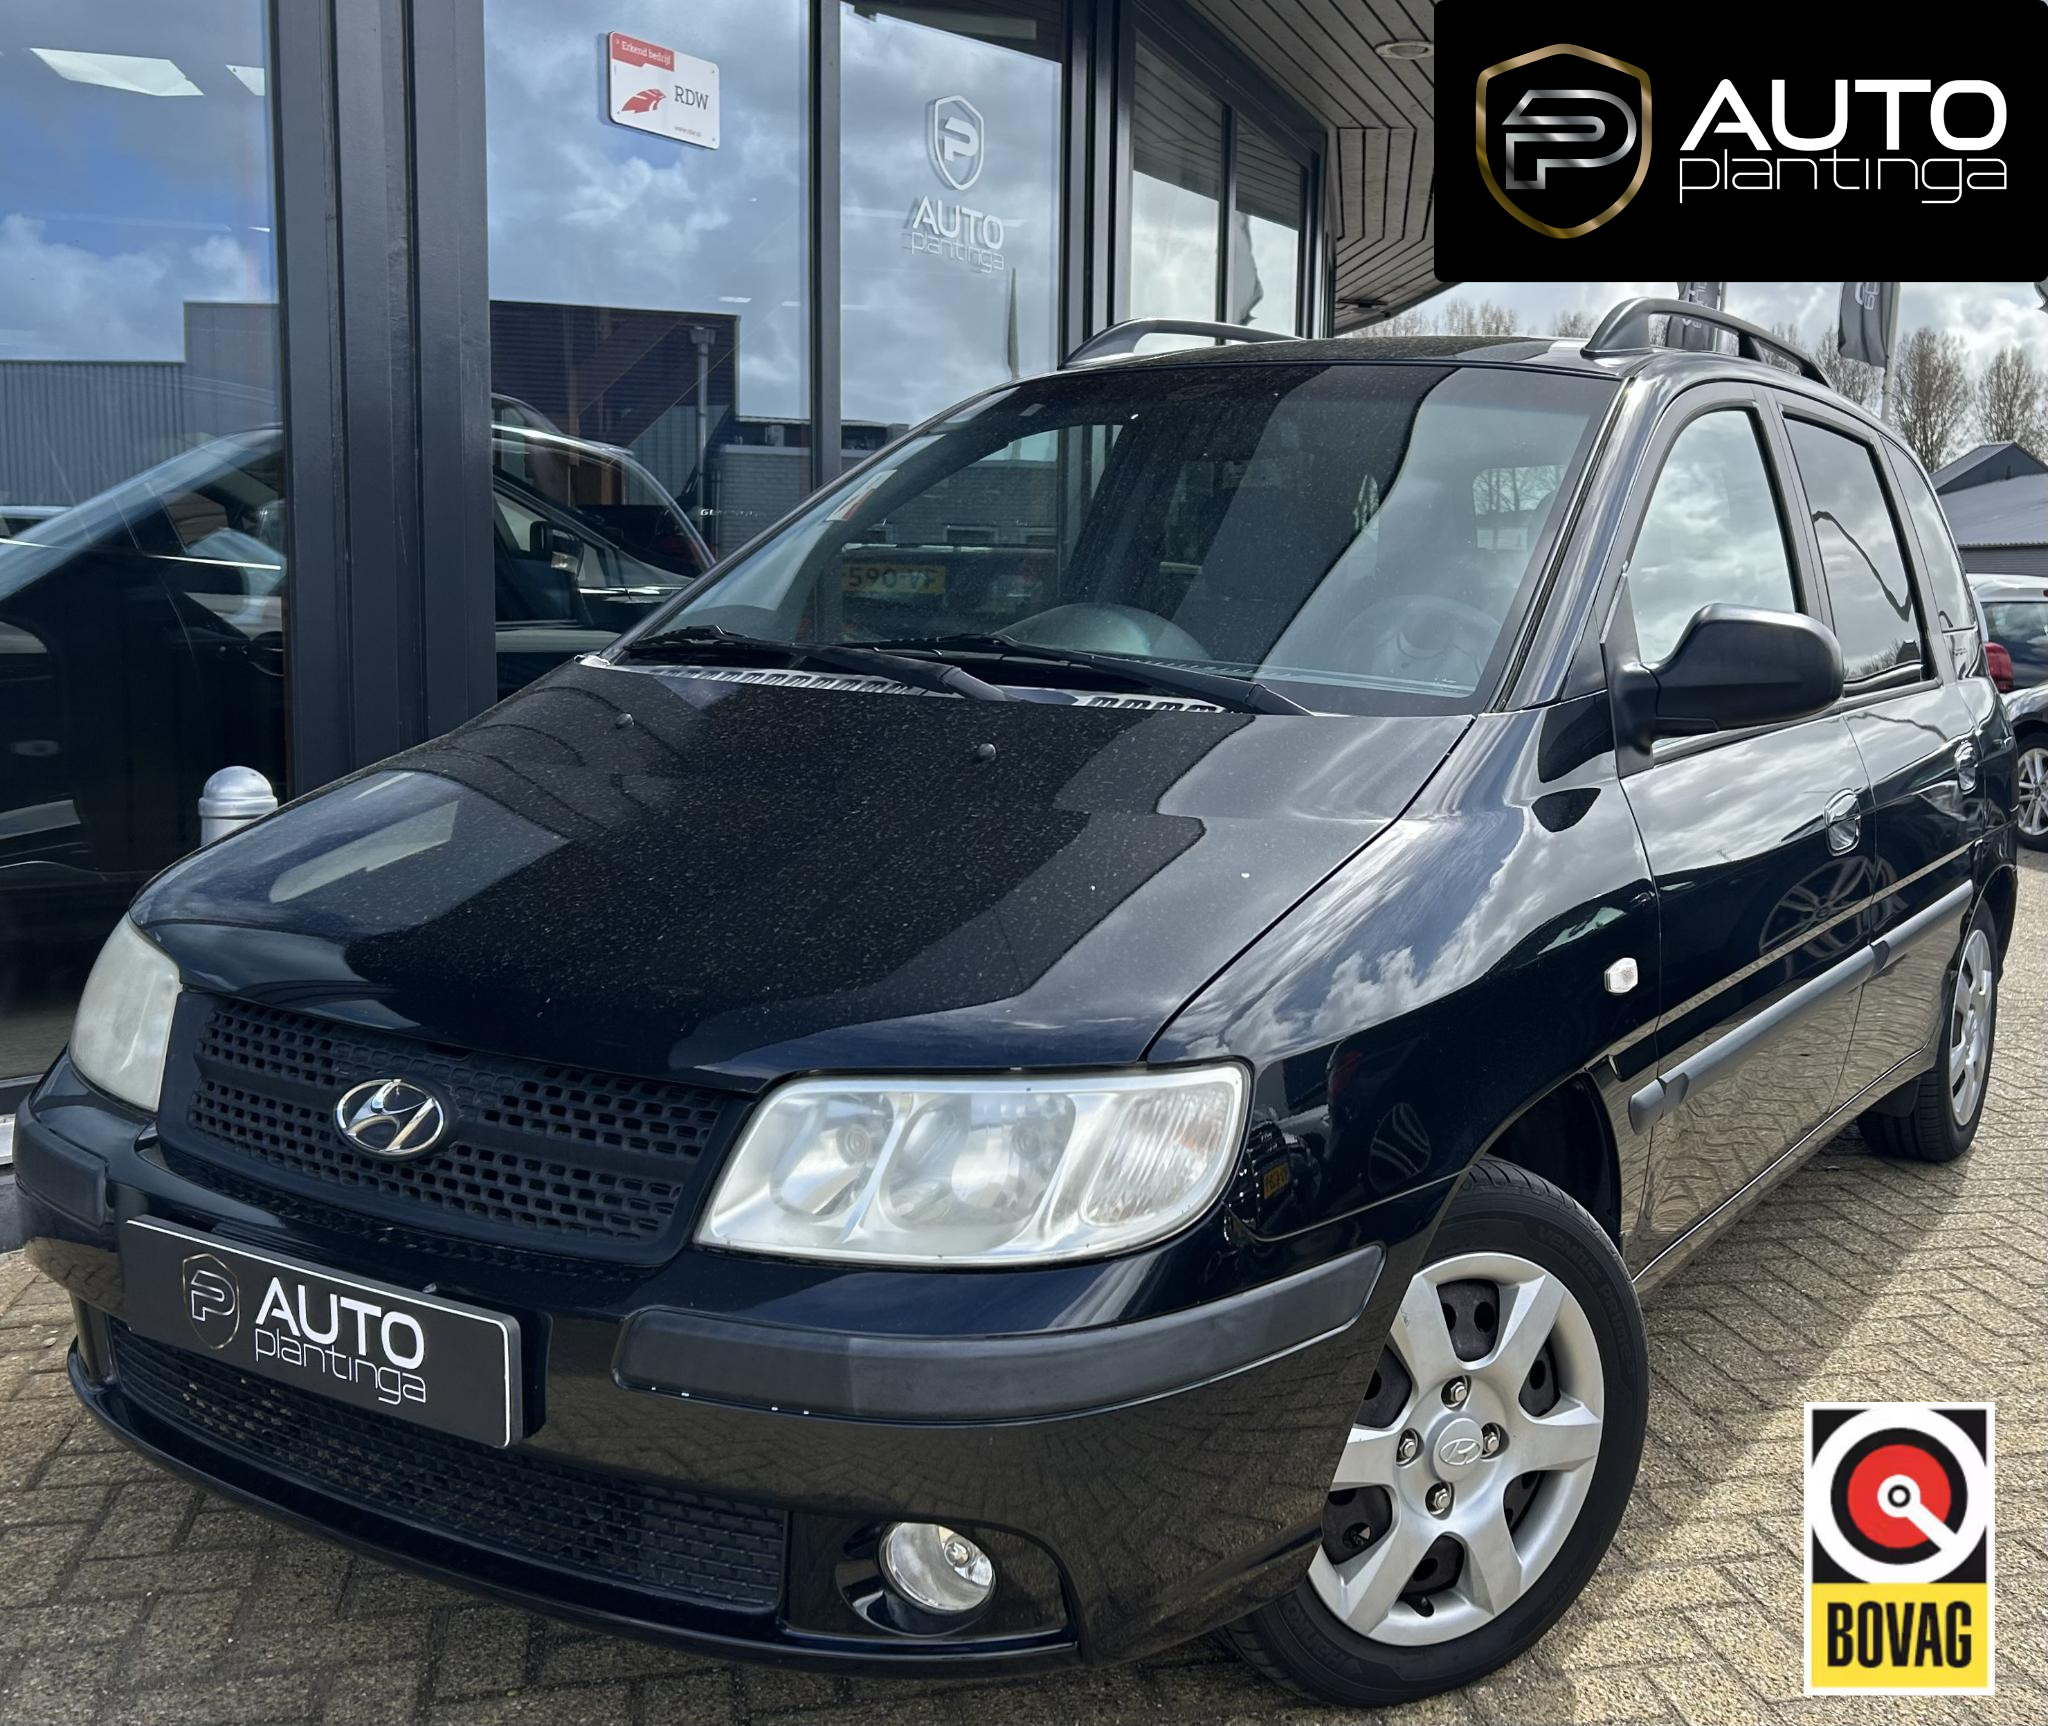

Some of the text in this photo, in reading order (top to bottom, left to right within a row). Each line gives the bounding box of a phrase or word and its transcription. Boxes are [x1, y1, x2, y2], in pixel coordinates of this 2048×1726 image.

[621, 41, 647, 57] Erkend
[674, 85, 709, 111] RDW
[912, 196, 1004, 249] AUTO
[911, 231, 1004, 273] plantinga
[255, 1276, 425, 1370] AUTO
[254, 1327, 427, 1405] plantinga
